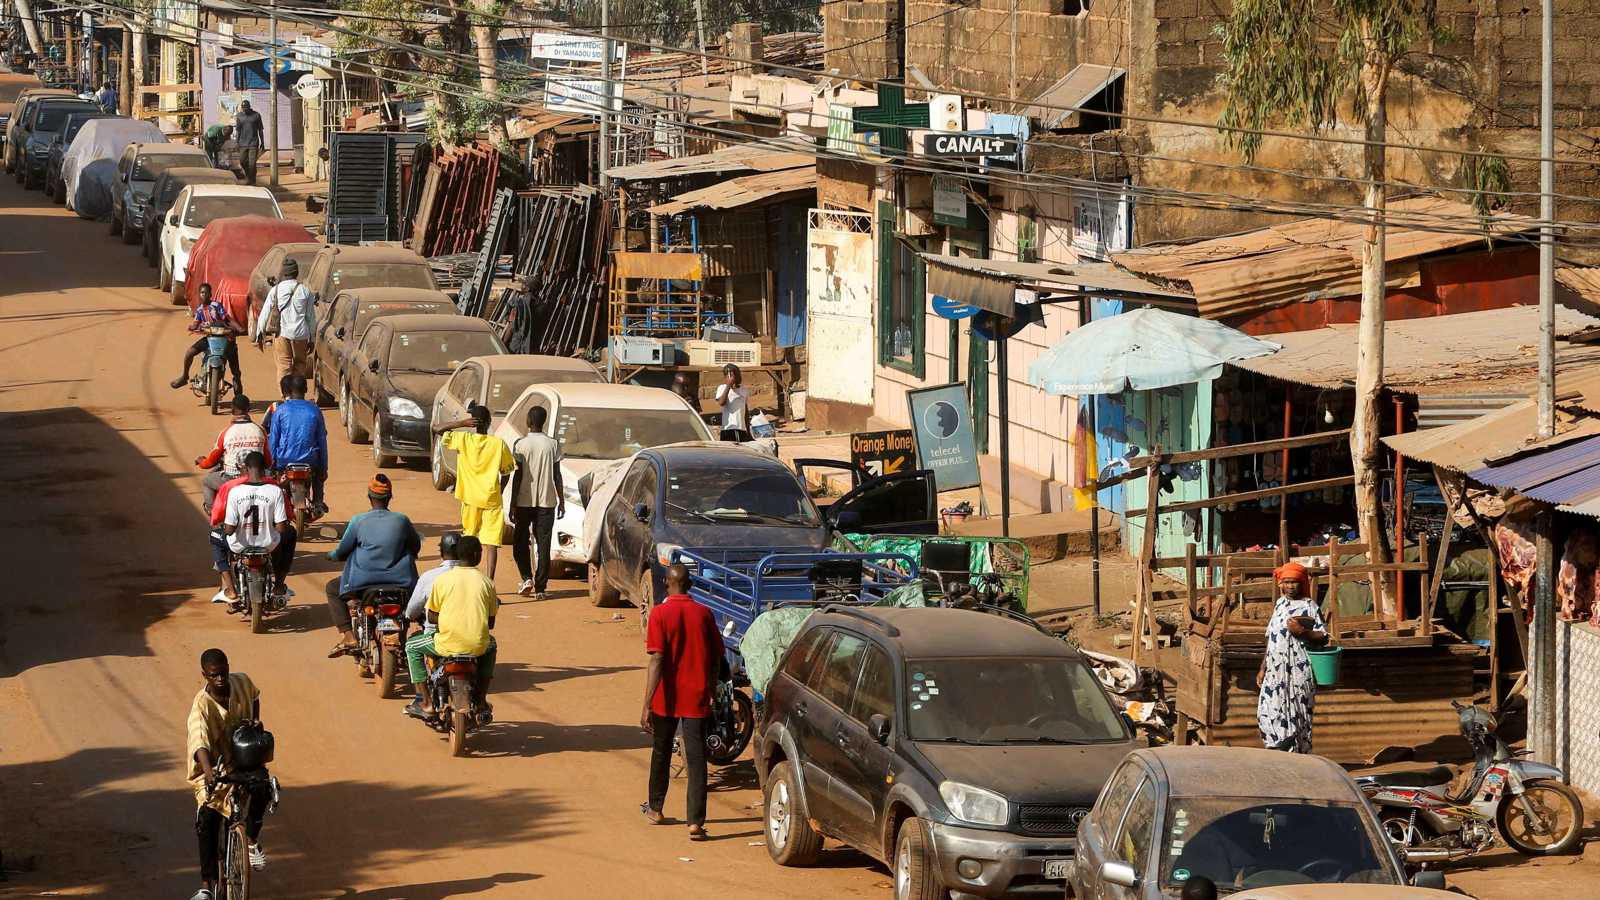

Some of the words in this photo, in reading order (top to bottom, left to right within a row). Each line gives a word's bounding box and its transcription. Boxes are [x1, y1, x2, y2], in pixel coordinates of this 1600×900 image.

[582, 41, 603, 49] MEDIC
[562, 49, 591, 57] YAMADOU
[935, 136, 1005, 153] CANAL+
[852, 436, 885, 455] Orange
[886, 433, 914, 454] Money
[930, 443, 961, 458] telecel
[237, 493, 271, 505] CHAMPION
[243, 505, 259, 536] 1
